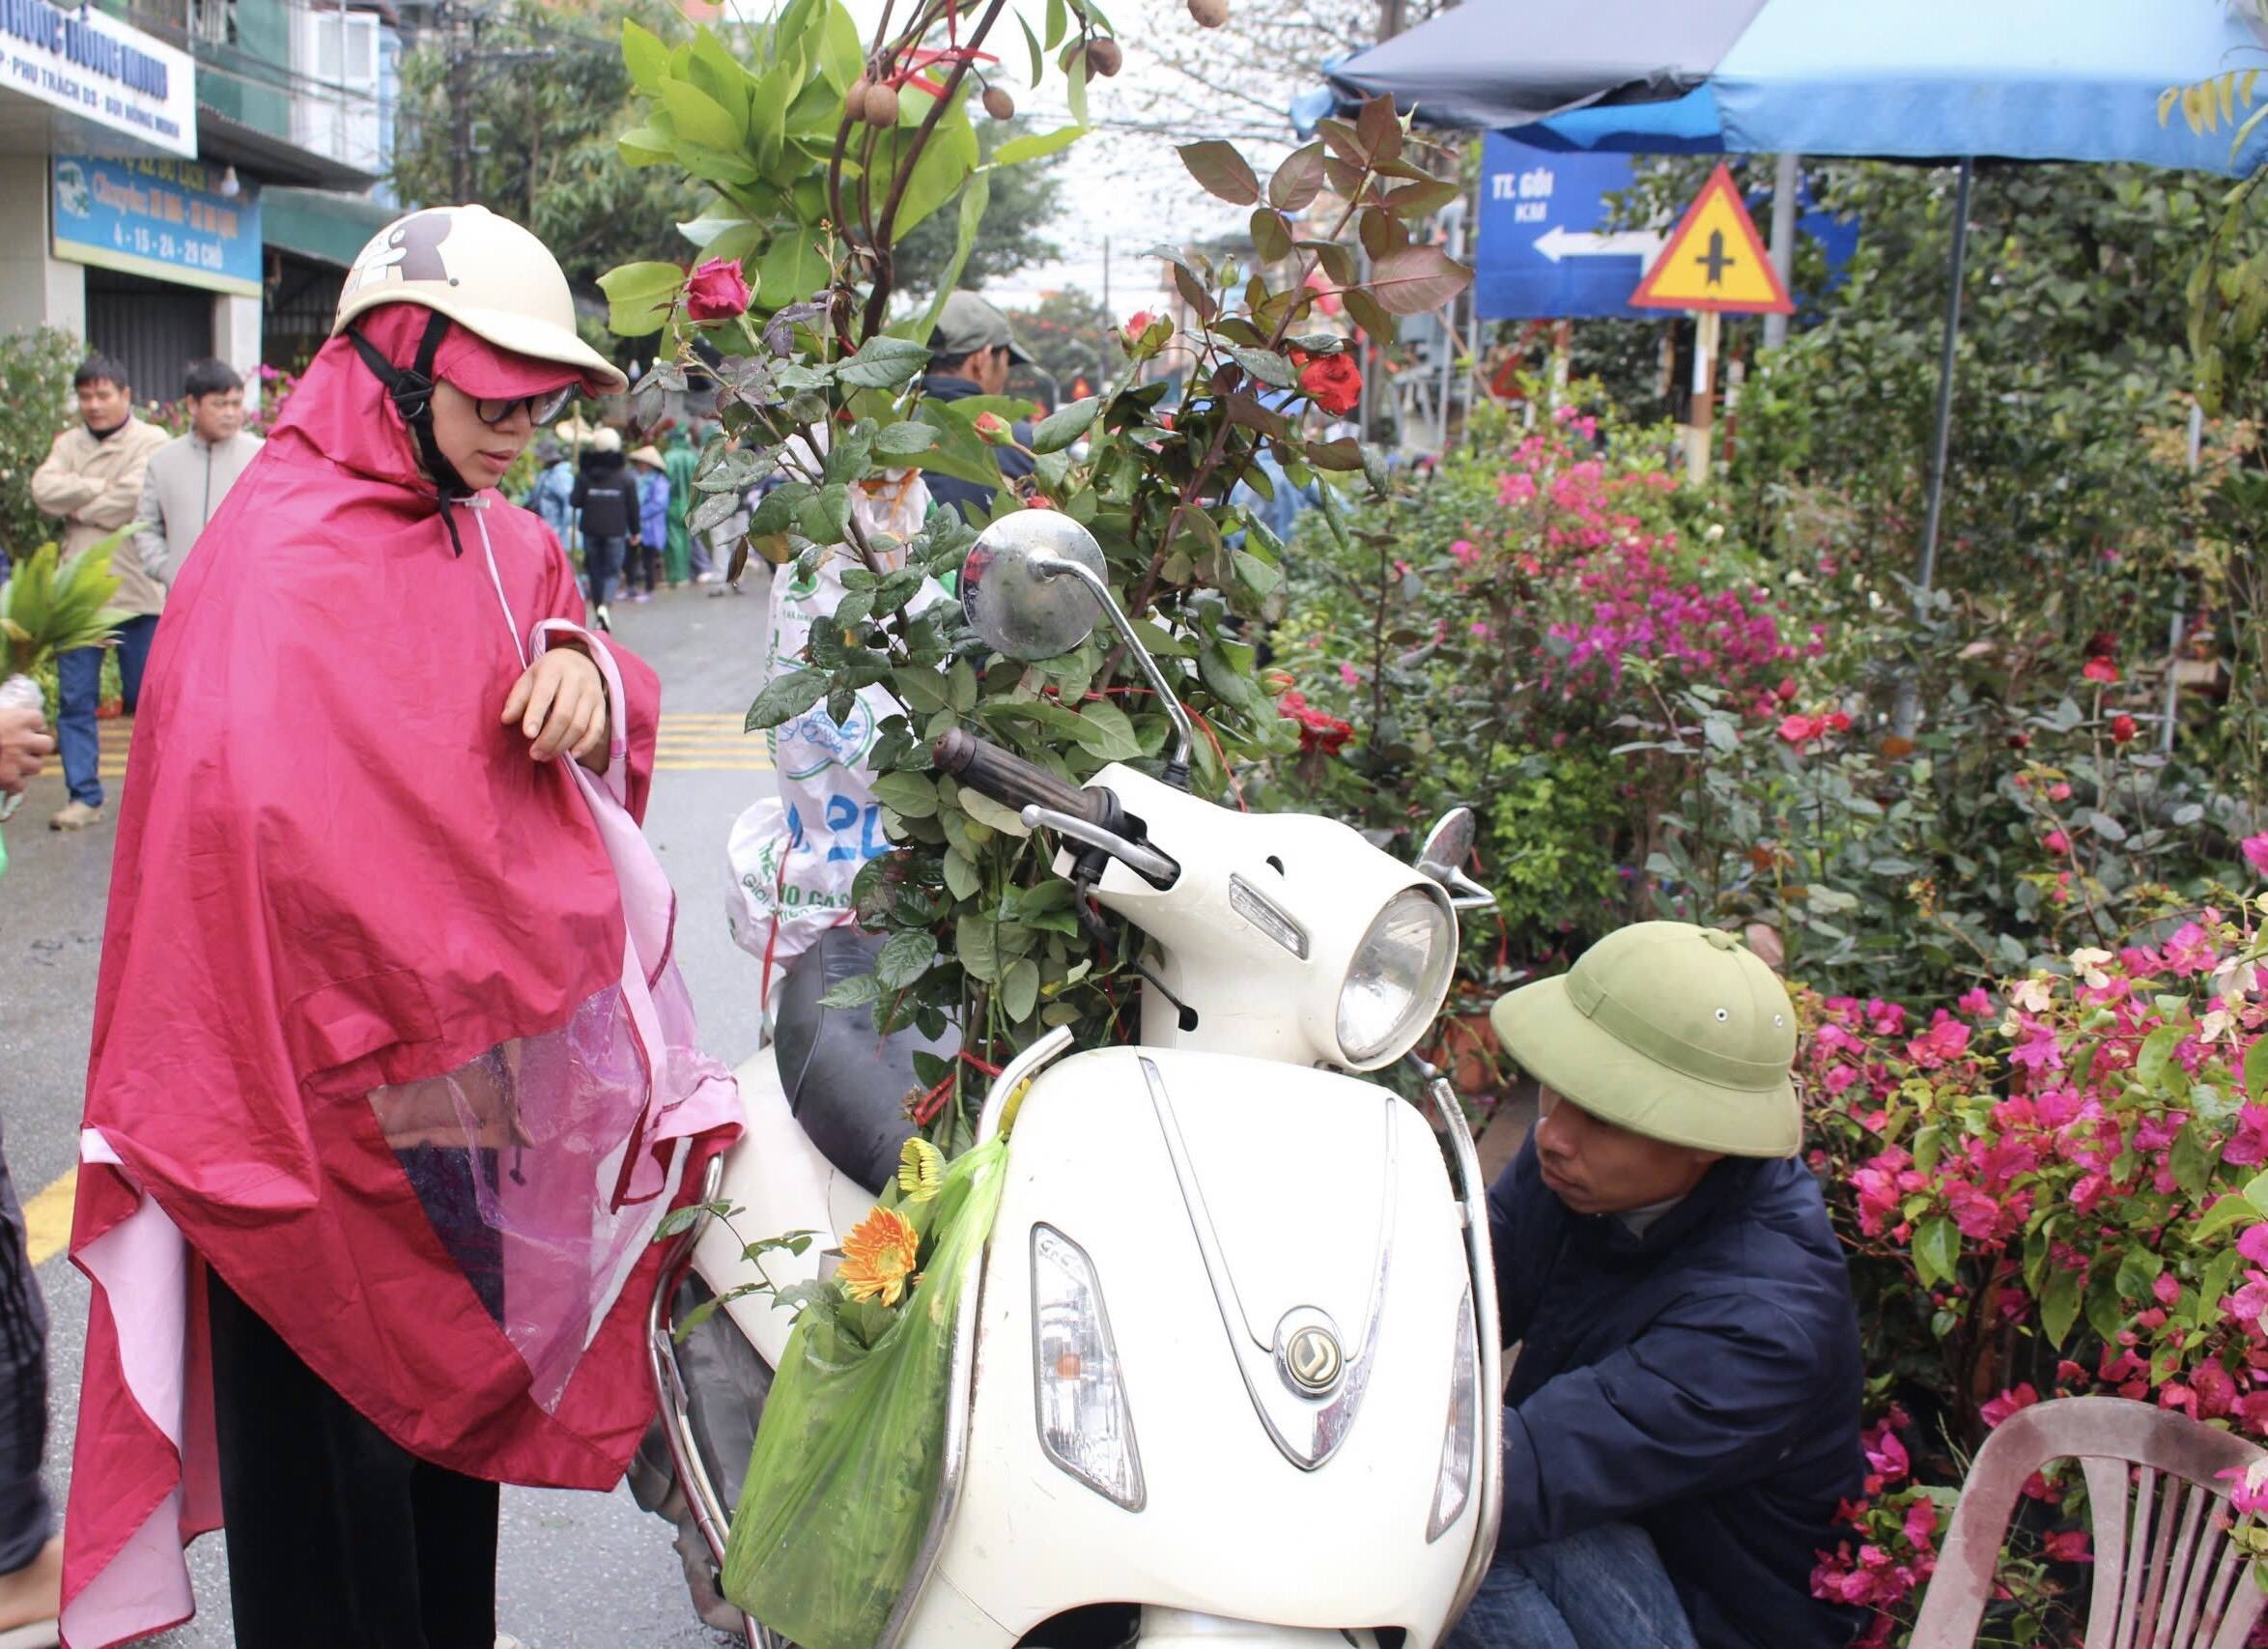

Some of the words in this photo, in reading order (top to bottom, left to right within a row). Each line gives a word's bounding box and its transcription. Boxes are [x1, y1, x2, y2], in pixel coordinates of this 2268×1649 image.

[1515, 202, 1547, 224] KM
[114, 220, 124, 247] 4
[134, 226, 150, 254] 15
[159, 232, 175, 260] 24
[184, 239, 199, 265] 29
